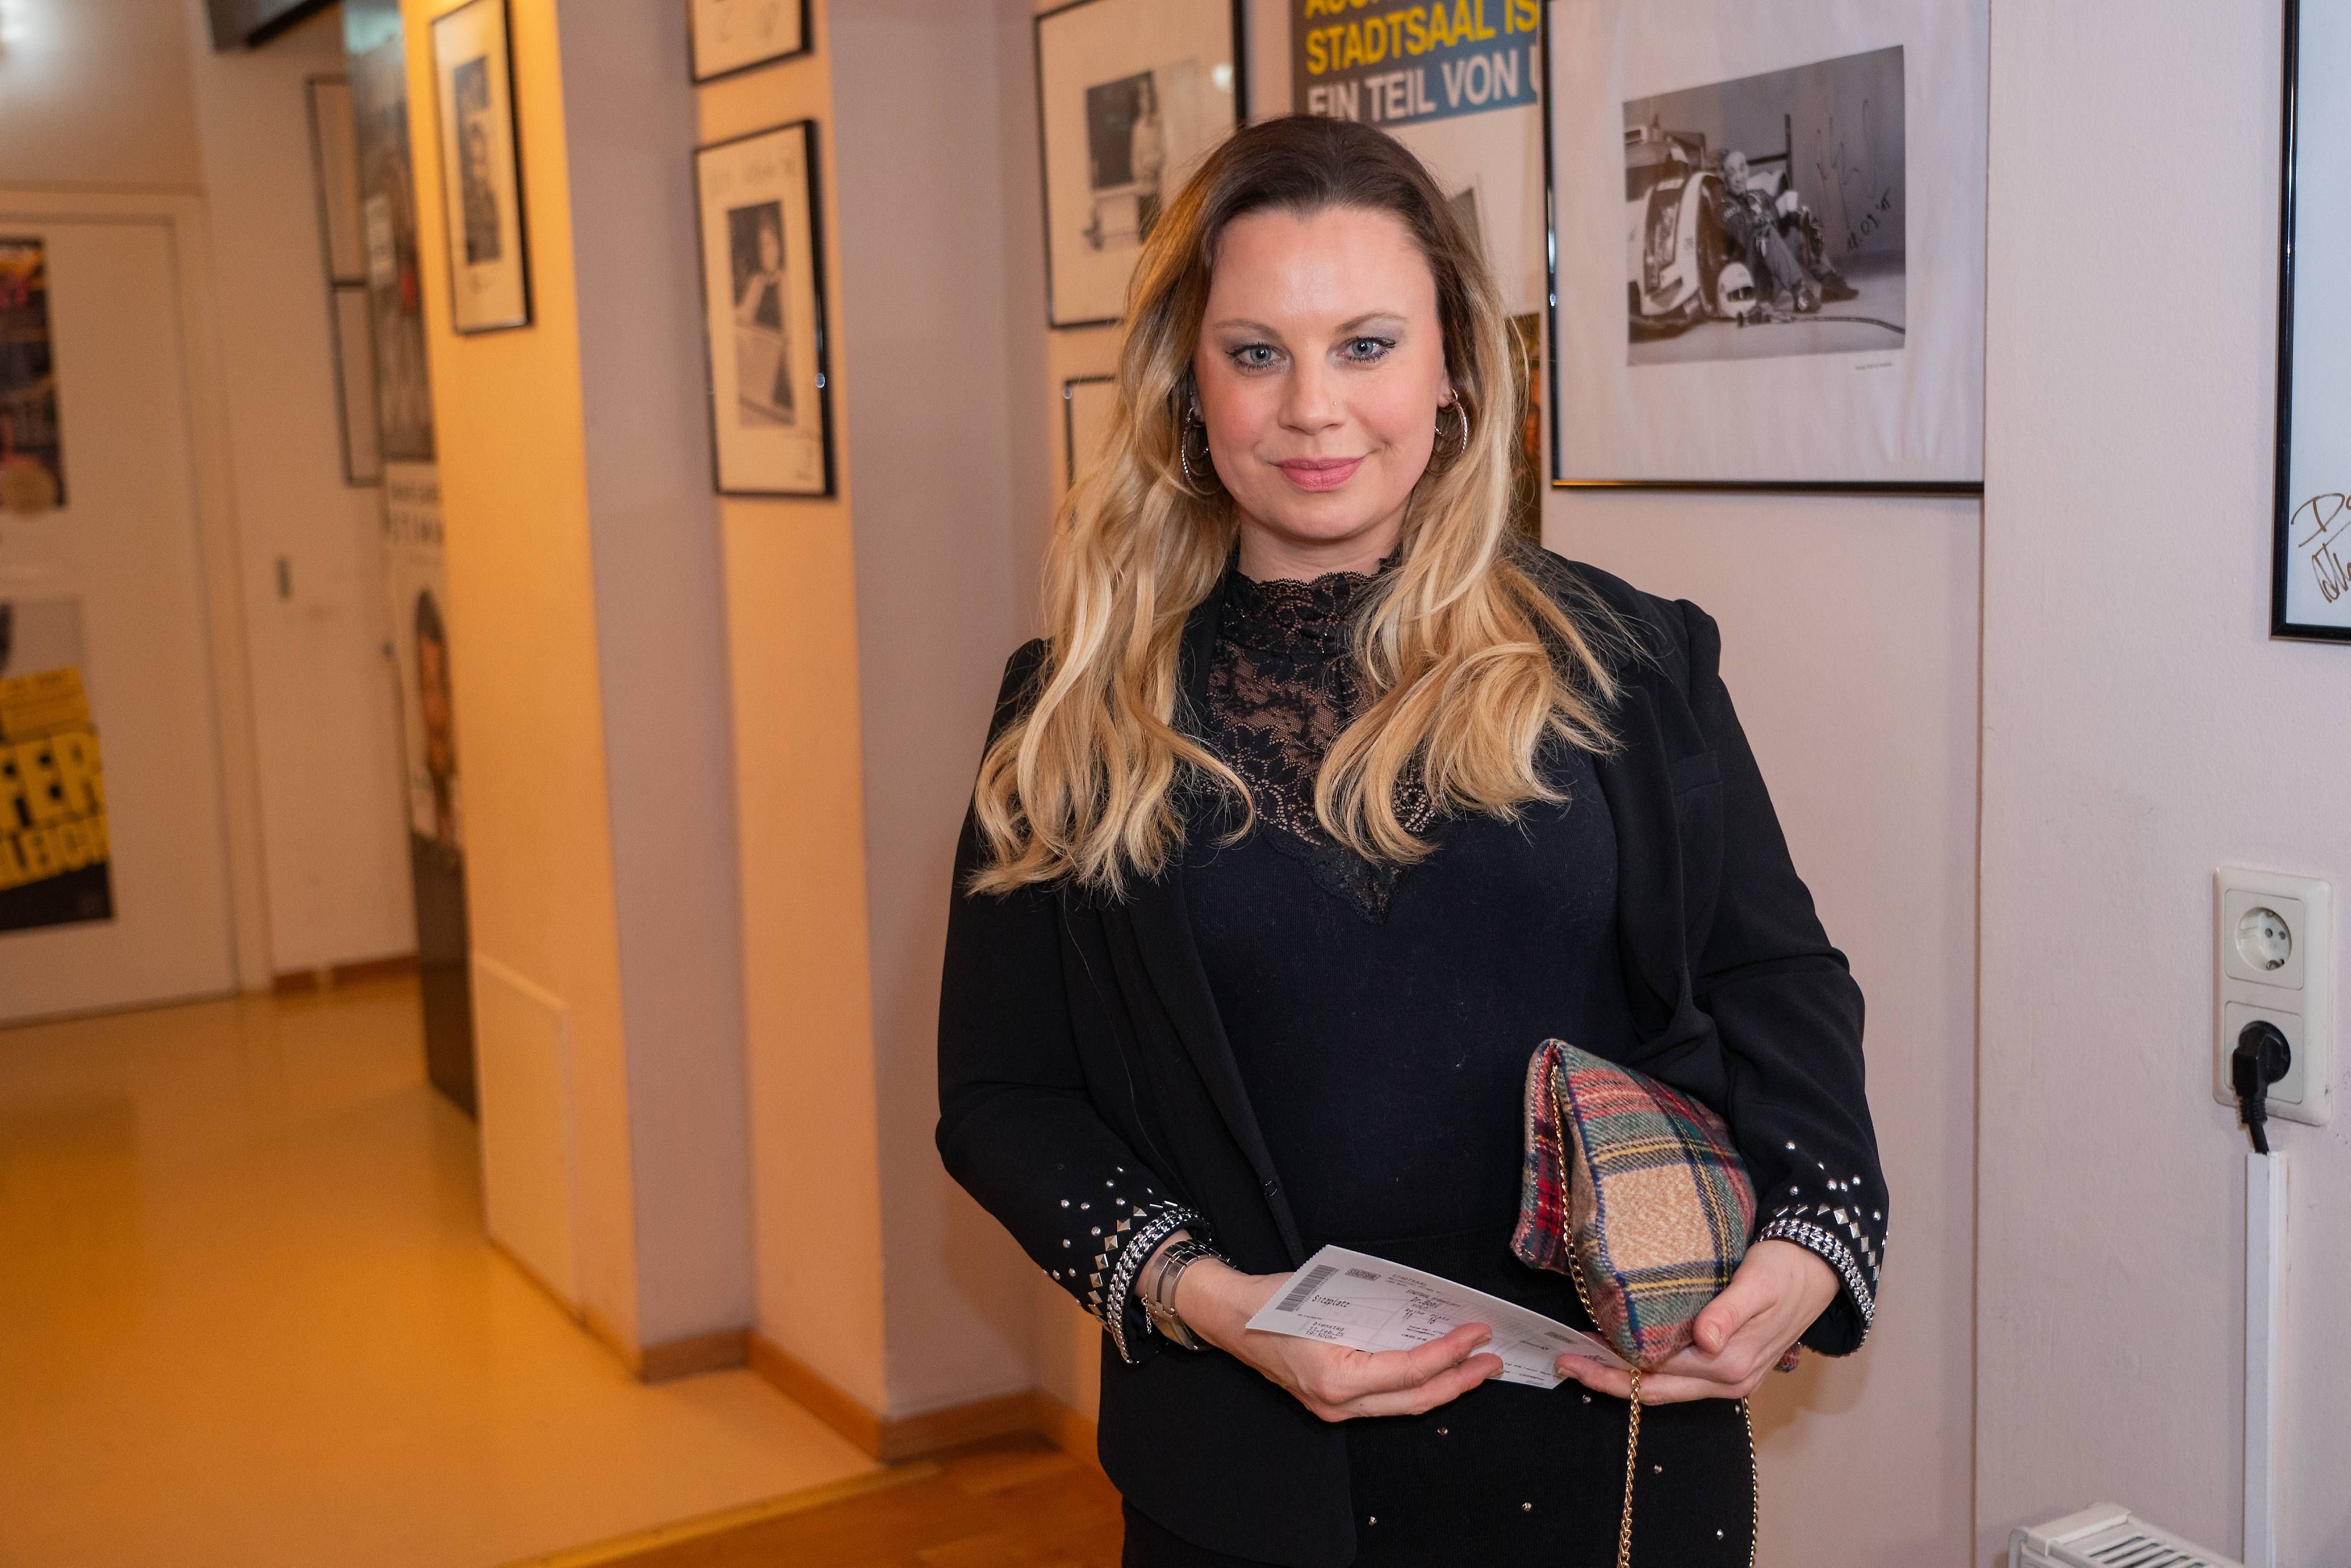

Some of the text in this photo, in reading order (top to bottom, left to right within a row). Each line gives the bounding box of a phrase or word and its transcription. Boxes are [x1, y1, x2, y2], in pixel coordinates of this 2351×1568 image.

[1307, 0, 1496, 75] STADTSAAL
[1364, 67, 1436, 122] TEIL
[1441, 48, 1519, 108] VON
[1312, 1295, 1350, 1308] Sitzplatz
[1309, 1326, 1345, 1336] 11.Feb.25
[1312, 1321, 1345, 1332] Dienstag
[1305, 1330, 1337, 1341] 19:30Uhr
